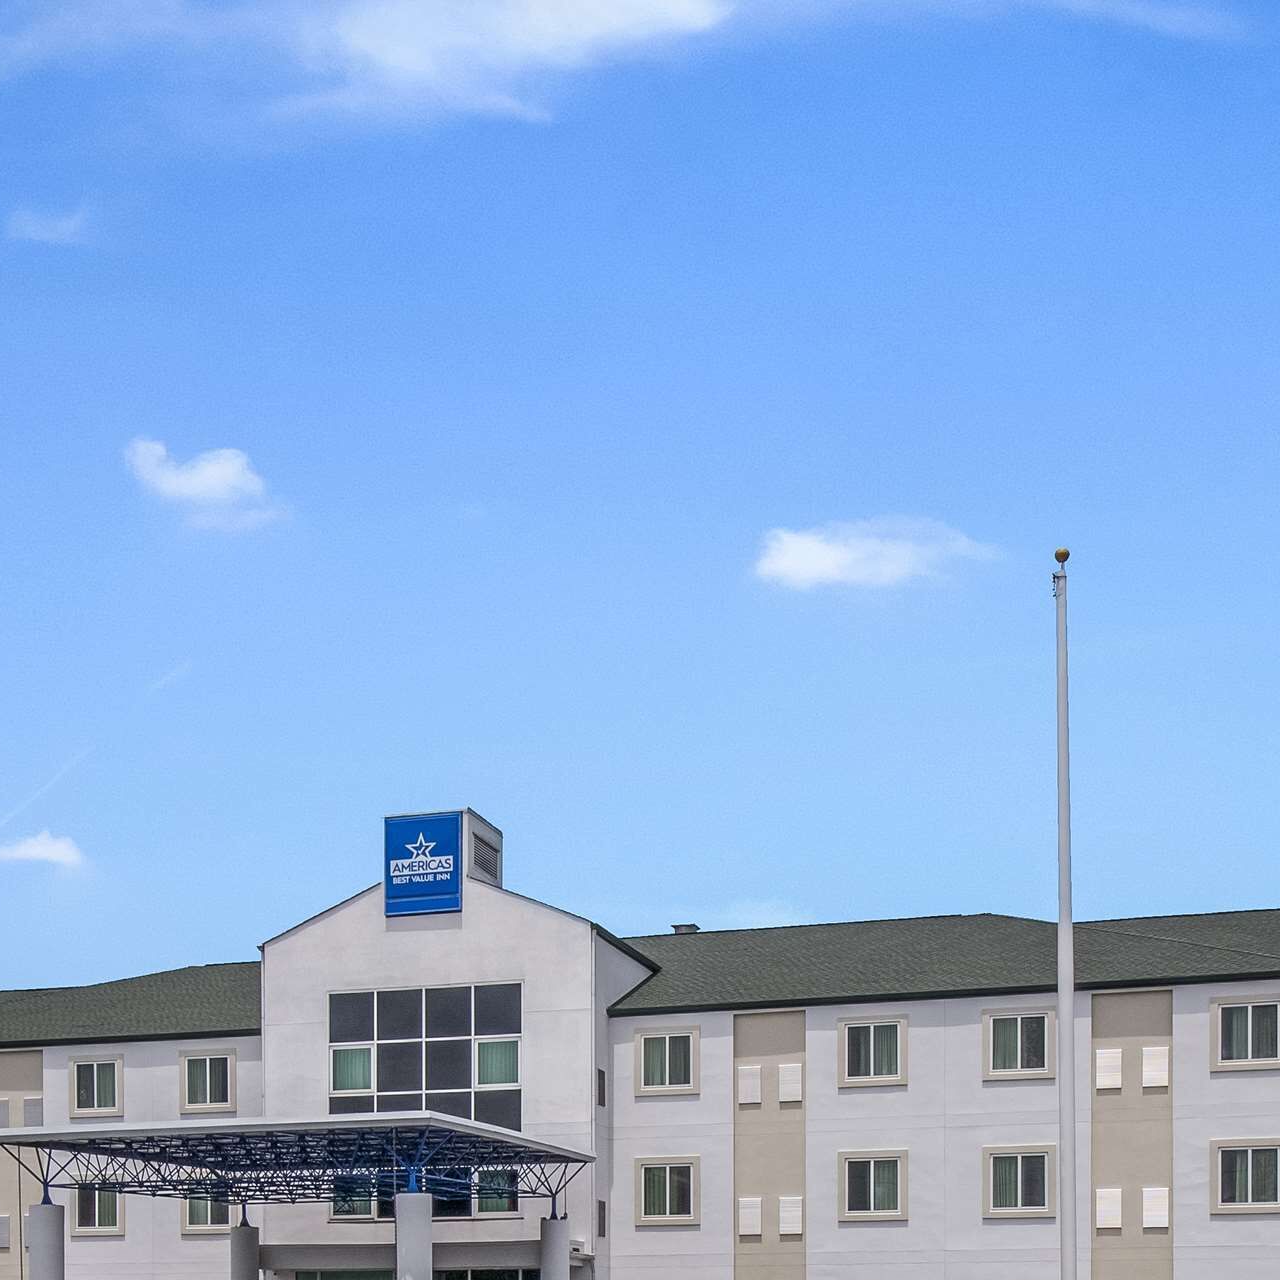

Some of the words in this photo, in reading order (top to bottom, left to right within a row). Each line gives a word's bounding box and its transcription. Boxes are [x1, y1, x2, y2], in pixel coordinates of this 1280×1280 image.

[392, 858, 452, 874] AMERICAS
[392, 876, 410, 885] BEST
[411, 874, 435, 883] VALUE
[436, 872, 450, 881] INN
